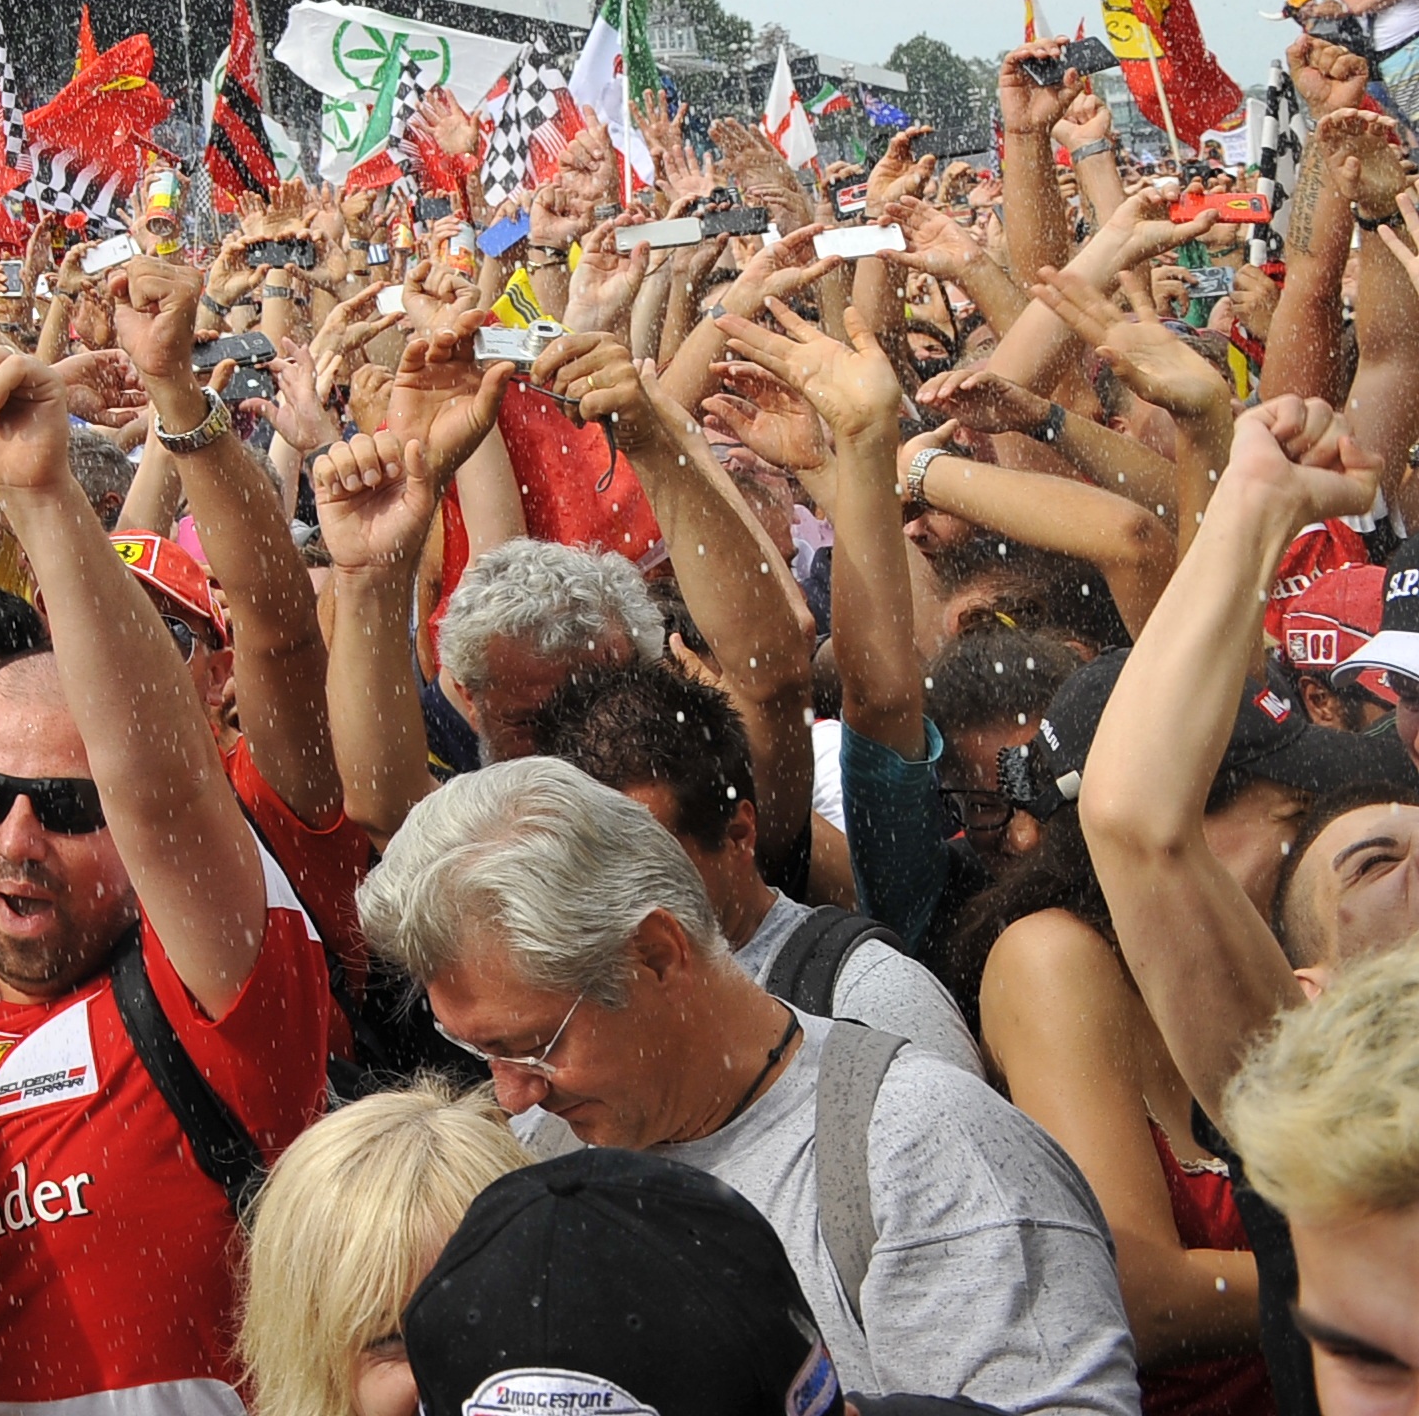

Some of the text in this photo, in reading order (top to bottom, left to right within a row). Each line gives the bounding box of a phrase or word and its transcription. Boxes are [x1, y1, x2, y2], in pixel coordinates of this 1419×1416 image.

[0, 1070, 67, 1096] SCUDERIA
[23, 1076, 85, 1099] FERRARI
[497, 1386, 614, 1409] BRIDGESTONE
